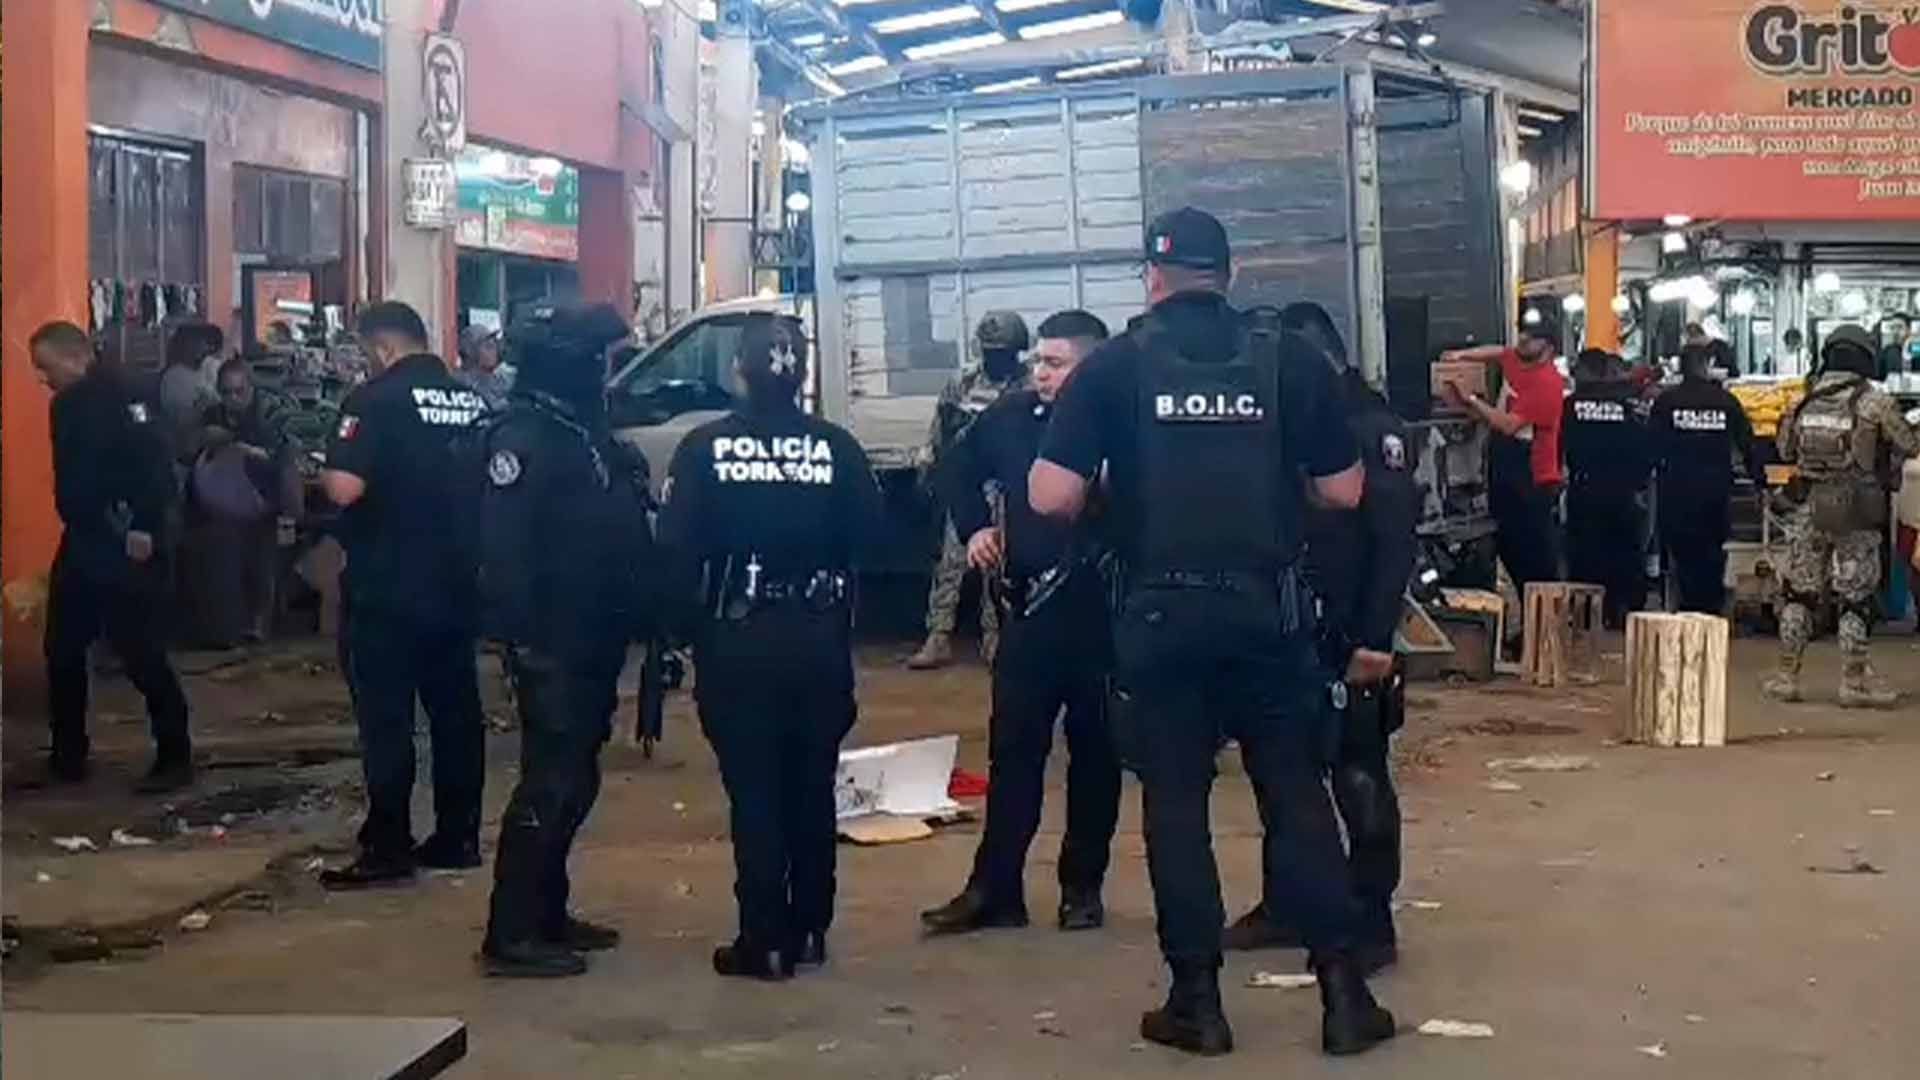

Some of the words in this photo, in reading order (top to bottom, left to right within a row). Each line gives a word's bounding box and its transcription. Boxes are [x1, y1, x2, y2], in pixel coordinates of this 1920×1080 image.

[1786, 86, 1913, 108] MERCADO
[1155, 394, 1264, 417] B.O.I.C.
[713, 434, 833, 461] POLICÍA
